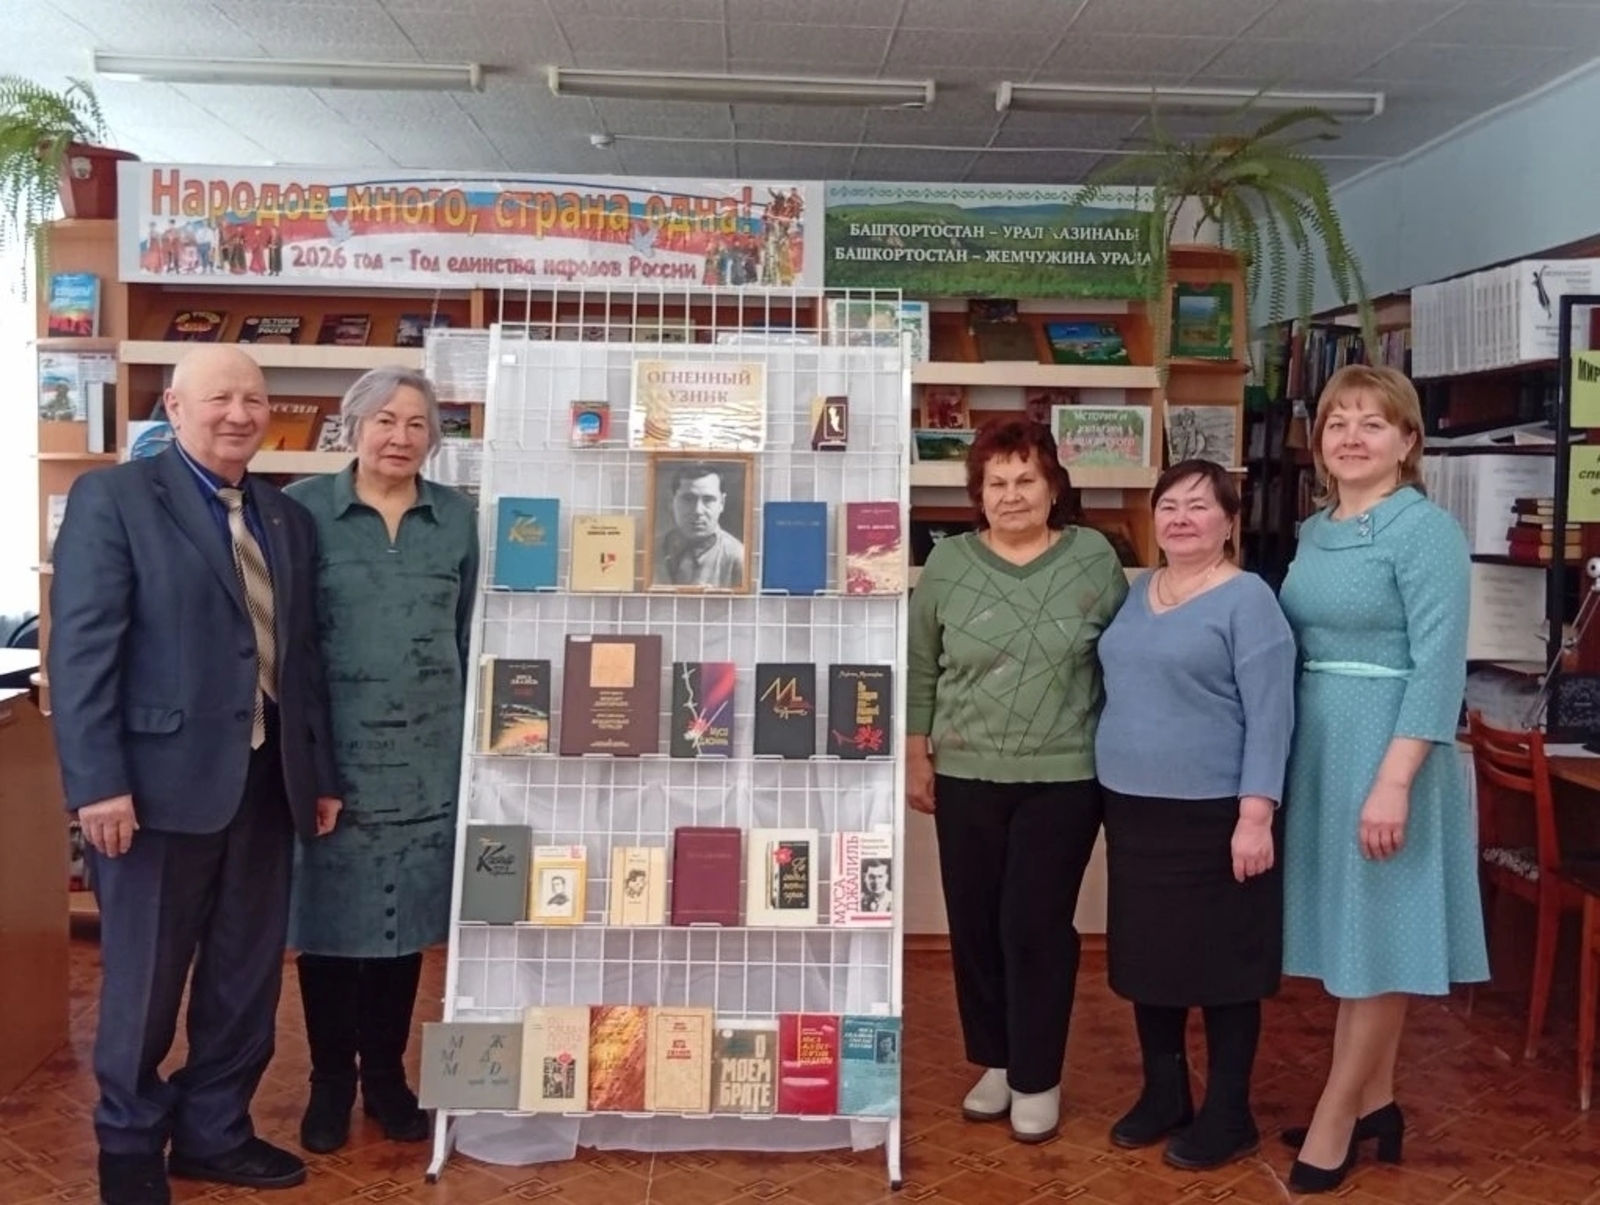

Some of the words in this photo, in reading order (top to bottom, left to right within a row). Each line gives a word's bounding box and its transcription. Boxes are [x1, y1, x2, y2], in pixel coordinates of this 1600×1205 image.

[152, 169, 329, 229] Народов
[347, 186, 478, 238] много,
[495, 189, 630, 240] страна
[646, 186, 753, 238] одна!
[1002, 225, 1044, 240] УРАЛ
[292, 246, 348, 269] 2026
[353, 254, 384, 271] год
[409, 250, 441, 273] Год
[447, 256, 537, 276] единства
[543, 257, 622, 281] народов
[629, 255, 698, 280] России
[834, 246, 968, 263] БАШКОРТОСТАН
[985, 249, 1097, 265] ЖЕМЧУЖИНА
[647, 369, 751, 386] ОГНЕННЫЙ
[669, 389, 729, 403] УЗНИК
[846, 835, 859, 913] ДЖАЛИЛЬ
[833, 878, 846, 925] МУСА
[721, 1057, 771, 1082] МОЕМ
[719, 1082, 771, 1112] БРАТЕ
